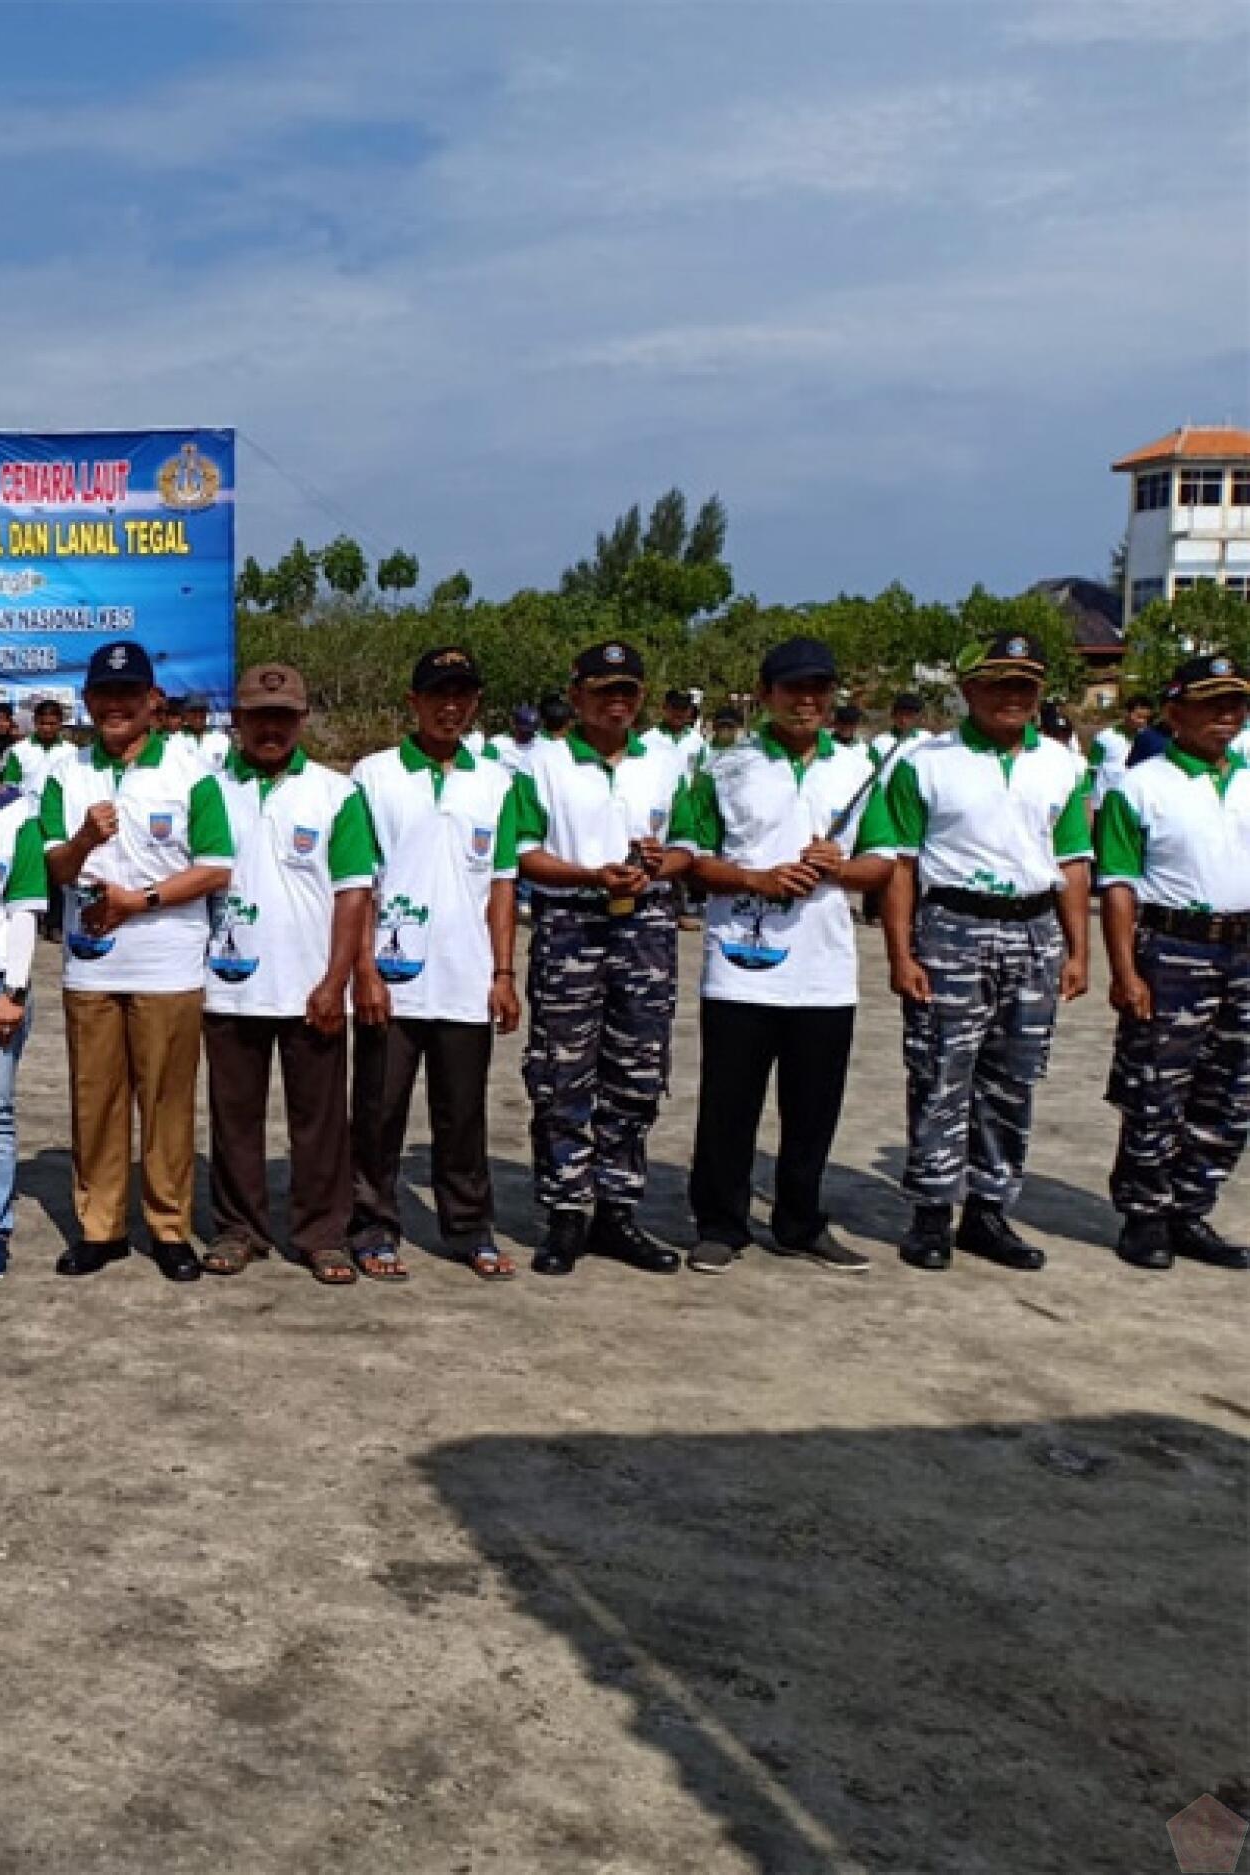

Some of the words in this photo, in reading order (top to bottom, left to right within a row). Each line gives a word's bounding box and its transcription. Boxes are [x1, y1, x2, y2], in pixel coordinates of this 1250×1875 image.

[2, 461, 76, 503] CEMARA
[80, 460, 131, 503] LAUT
[9, 522, 48, 555] DAN
[55, 521, 119, 554] LANAL
[125, 520, 190, 554] TEGAL
[17, 607, 94, 631] NASIONAL
